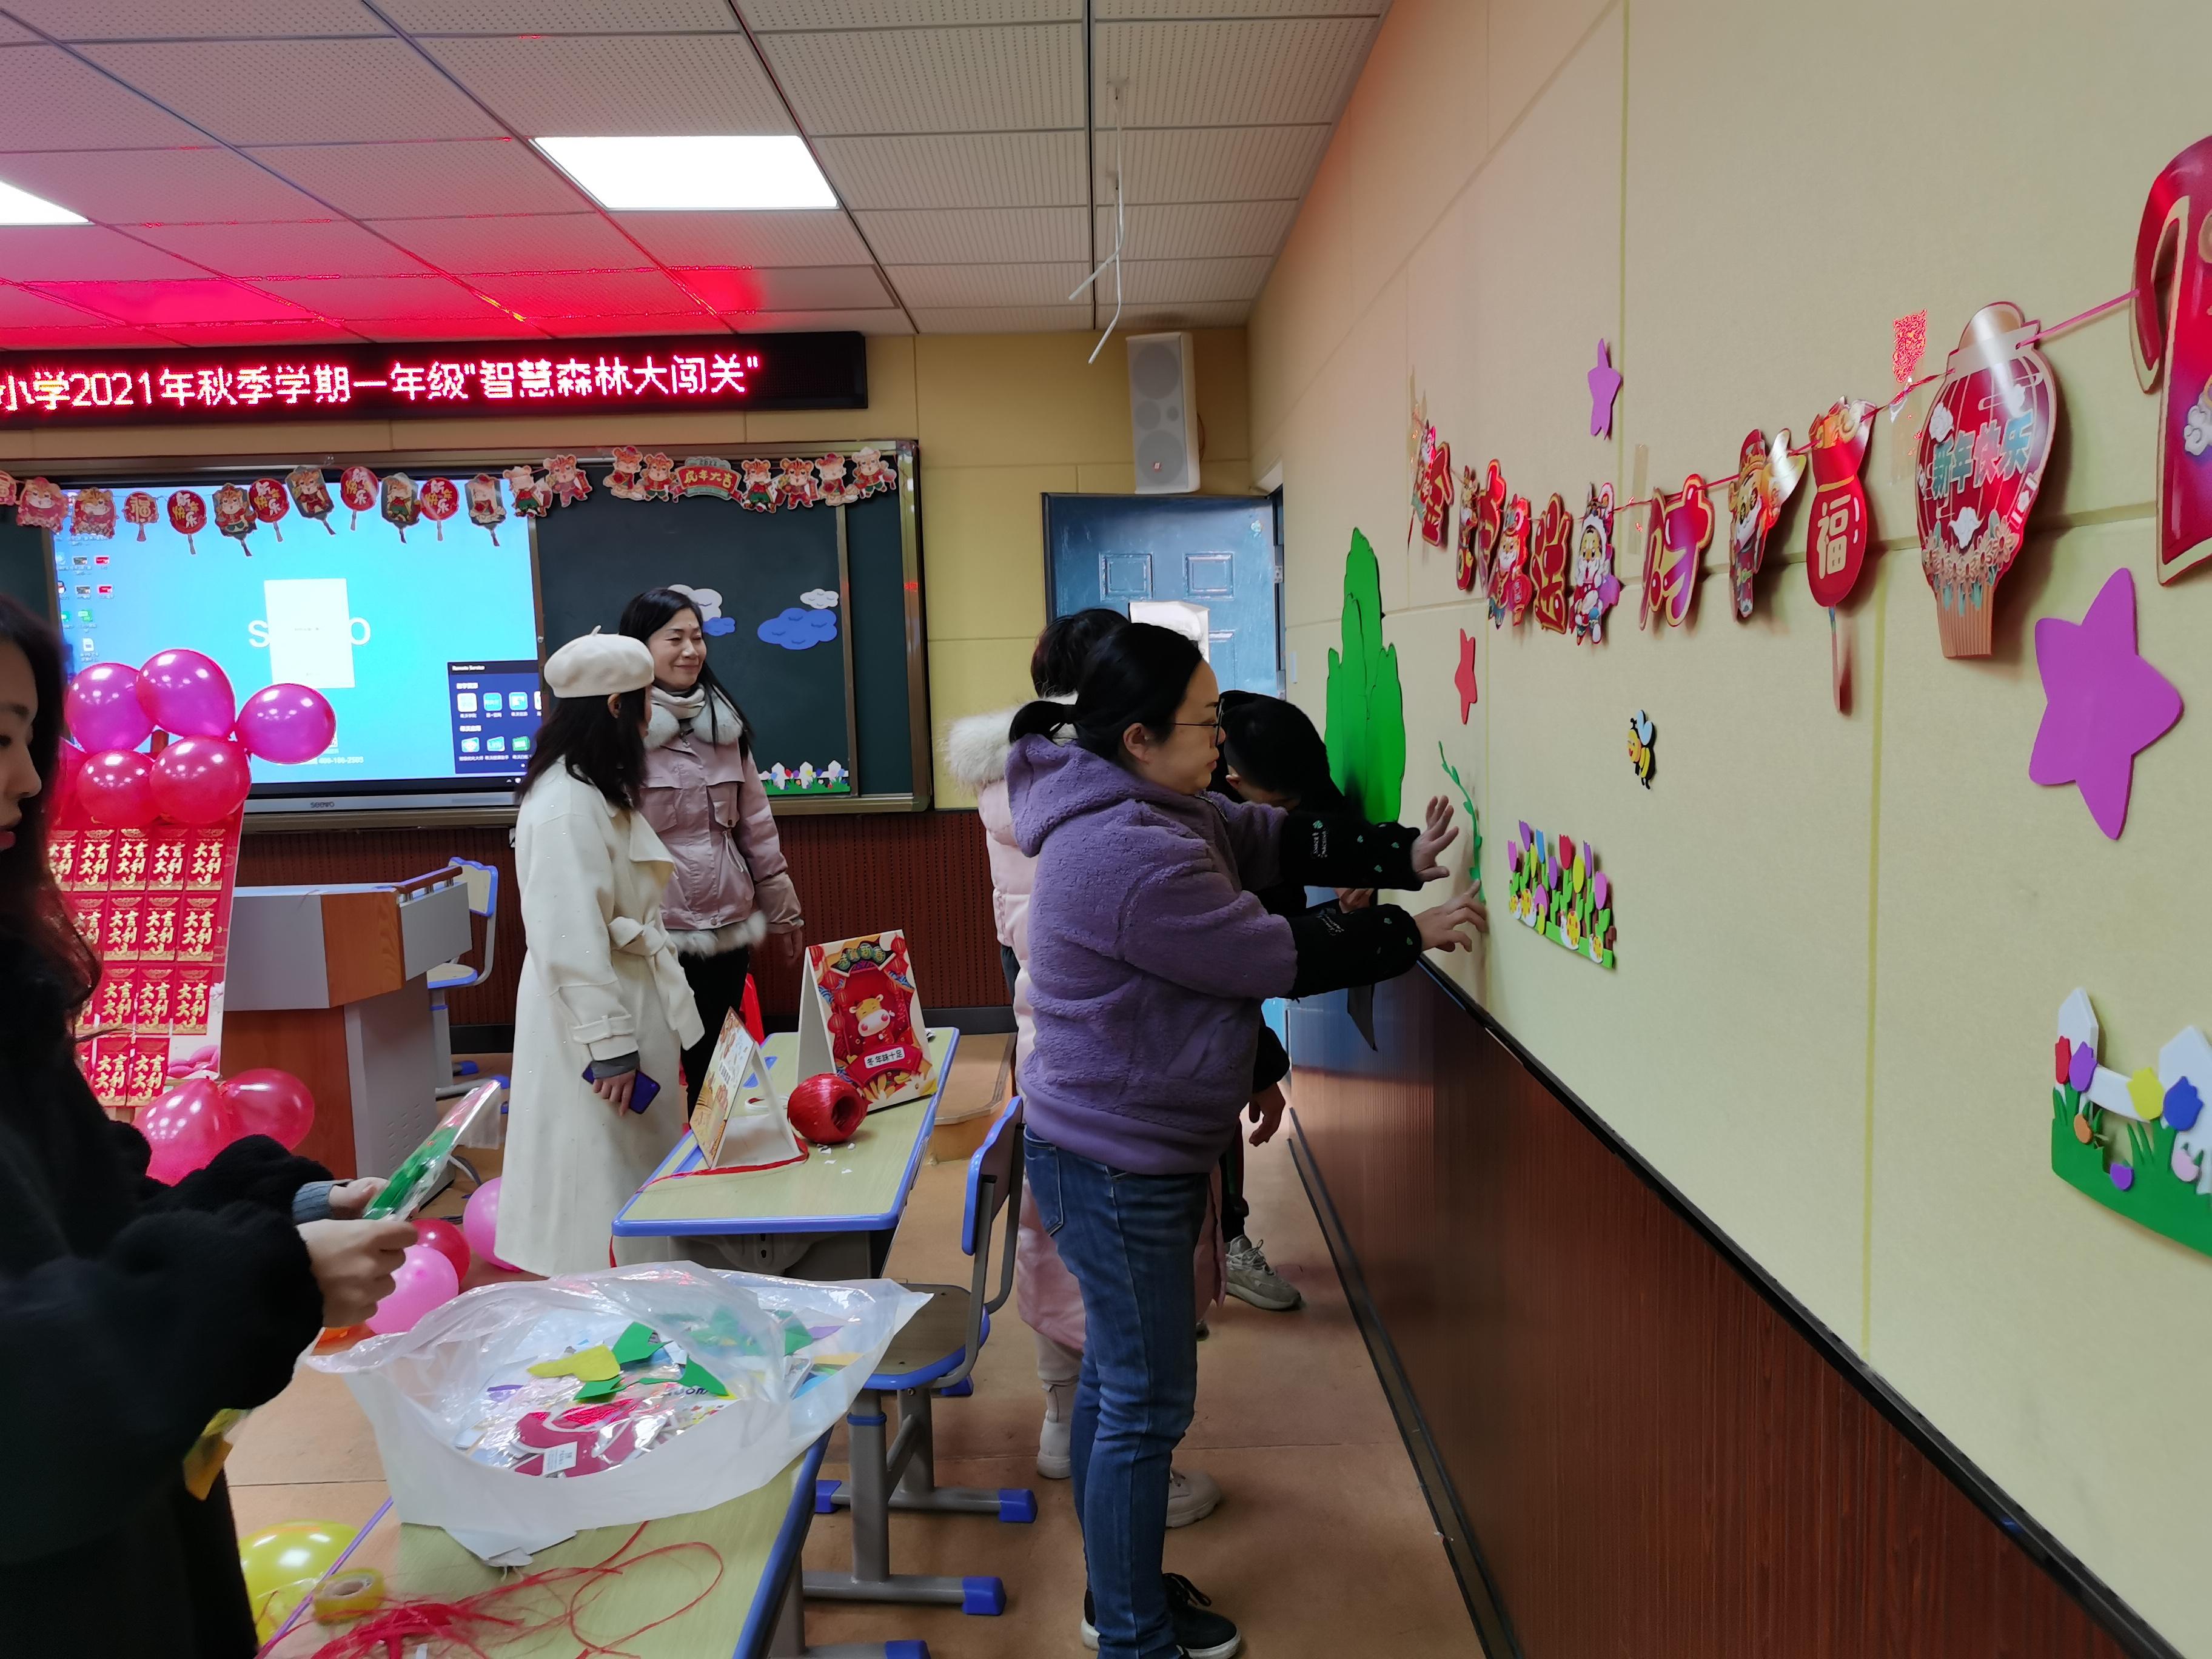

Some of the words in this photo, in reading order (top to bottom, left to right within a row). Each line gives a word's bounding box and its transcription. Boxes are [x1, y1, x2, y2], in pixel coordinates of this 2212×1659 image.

[0, 354, 759, 411] 小学2021年秋季学期一年级"智慧森林大闯关"
[1931, 408, 2033, 500] 新年快乐
[683, 469, 733, 488] 虎年大吉
[130, 494, 152, 523] 福
[1817, 494, 1851, 579] 福
[81, 842, 112, 859] 大吉
[118, 841, 149, 858] 大吉
[155, 842, 186, 858] 大吉
[193, 842, 224, 858] 大吉
[79, 859, 109, 874] 大利
[116, 858, 146, 874] 大利
[153, 858, 183, 874] 大利
[191, 857, 222, 874] 大利
[109, 910, 139, 927] 大吉
[146, 910, 176, 927] 大吉
[184, 911, 215, 928] 大吉
[107, 927, 138, 943] 大利
[144, 927, 174, 943] 大利
[182, 927, 213, 944] 大利
[103, 981, 133, 999] 大吉
[139, 982, 170, 999] 大吉
[178, 982, 208, 1000] 大吉
[101, 999, 132, 1016] 大利
[138, 999, 169, 1016] 大利
[175, 1000, 206, 1017] 大利
[96, 1054, 128, 1071] 大吉
[134, 1054, 165, 1072] 大吉
[95, 1071, 126, 1089] 大利
[132, 1071, 163, 1090] 大利
